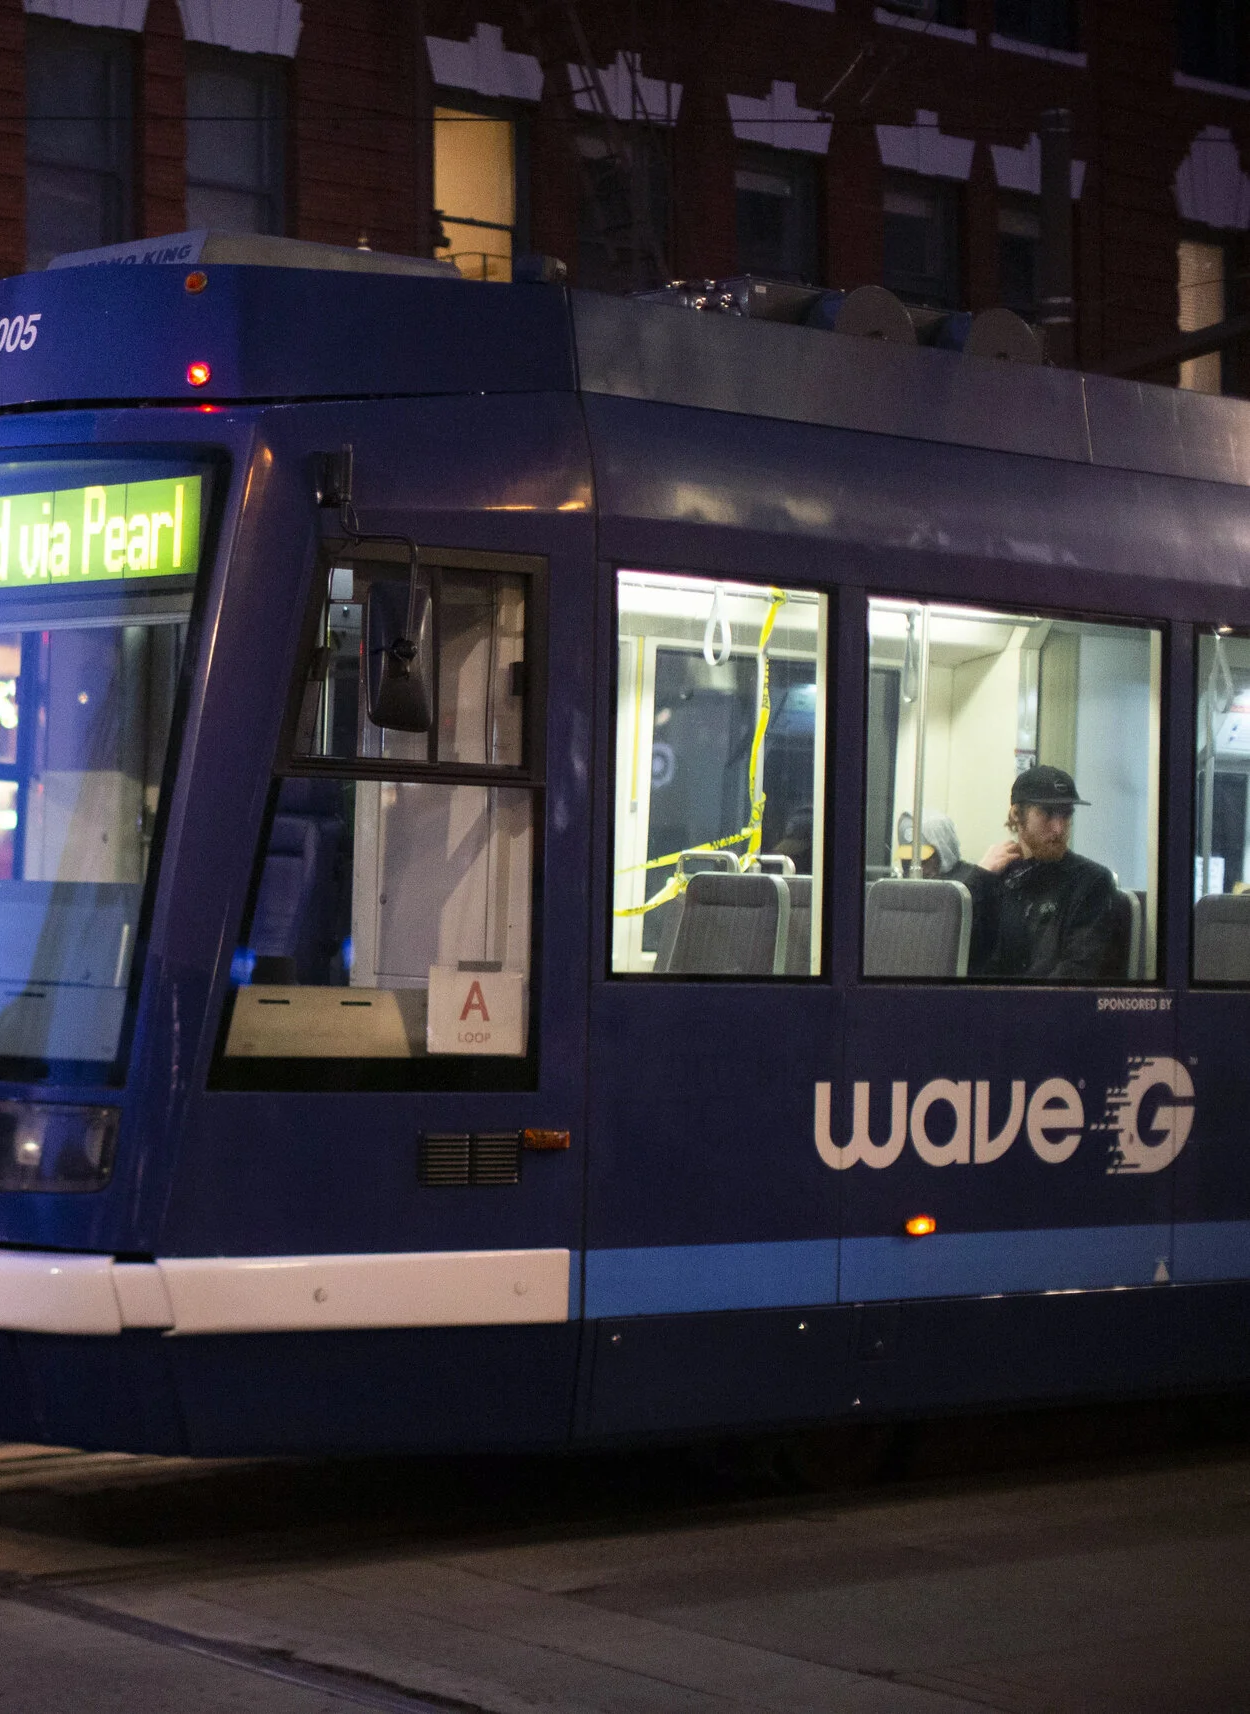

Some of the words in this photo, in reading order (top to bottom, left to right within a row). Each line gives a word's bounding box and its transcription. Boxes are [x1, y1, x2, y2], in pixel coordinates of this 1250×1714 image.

[143, 244, 192, 265] KING
[19, 501, 71, 579] via
[81, 484, 184, 575] Pearl
[459, 980, 490, 1022] A
[1097, 998, 1157, 1011] SPONSORED
[1159, 998, 1172, 1011] BY
[458, 1032, 491, 1044] LOOP
[814, 1077, 1085, 1170] wave
[1090, 1056, 1196, 1174] G
